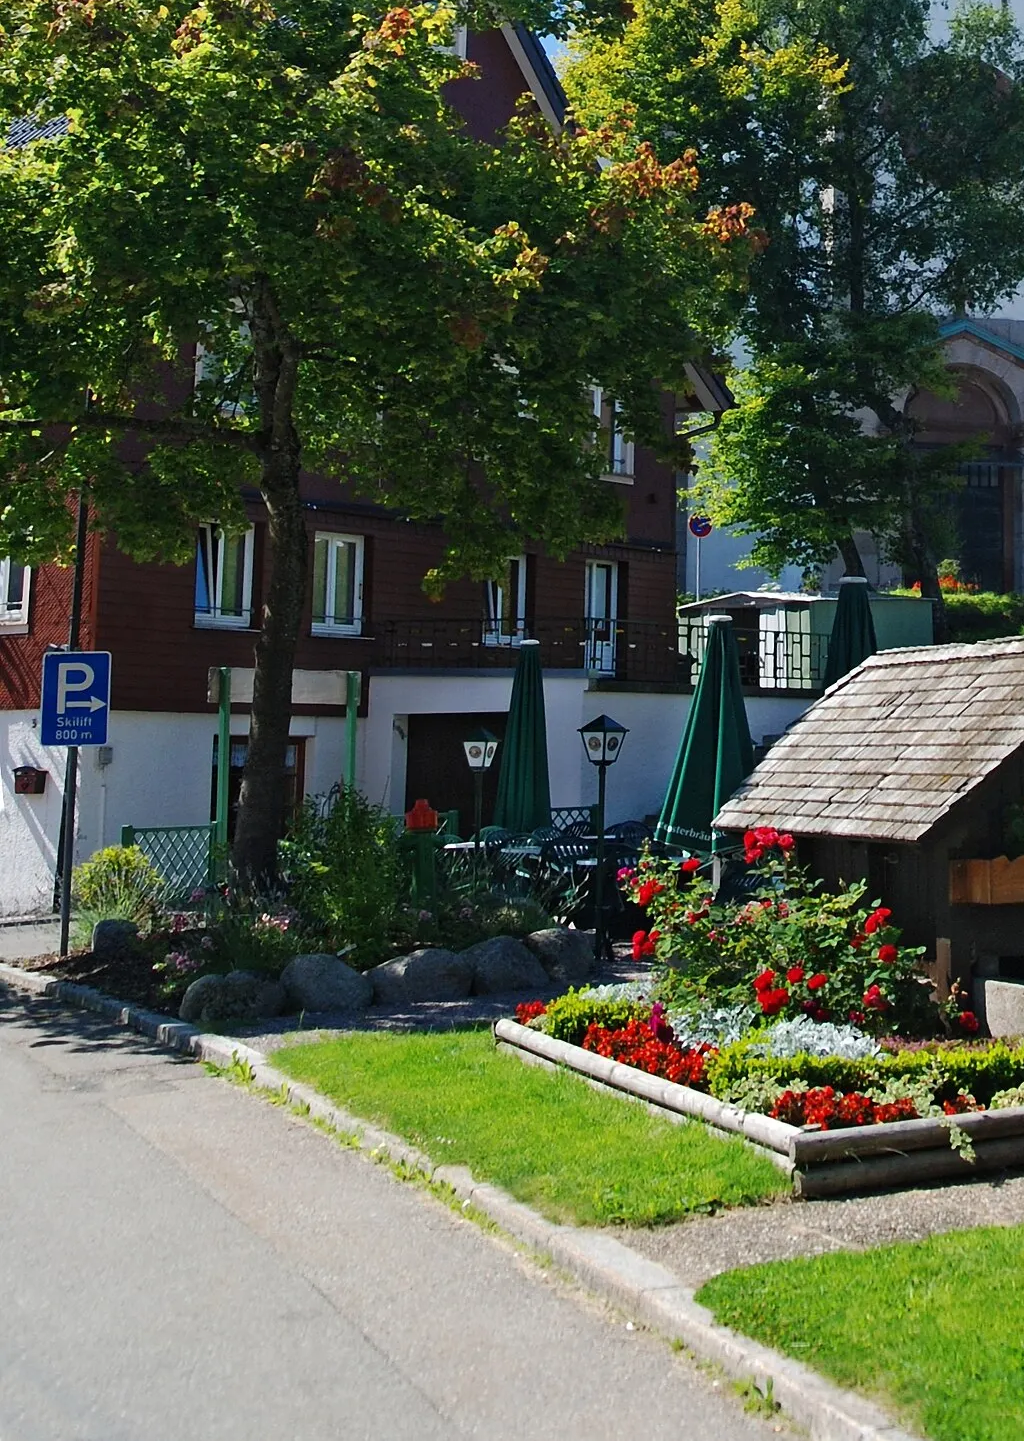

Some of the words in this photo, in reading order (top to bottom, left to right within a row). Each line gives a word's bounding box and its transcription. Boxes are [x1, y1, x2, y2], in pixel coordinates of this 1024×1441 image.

[57, 662, 95, 715] P
[56, 717, 92, 727] Skilift
[55, 729, 78, 740] 800
[81, 731, 92, 740] m
